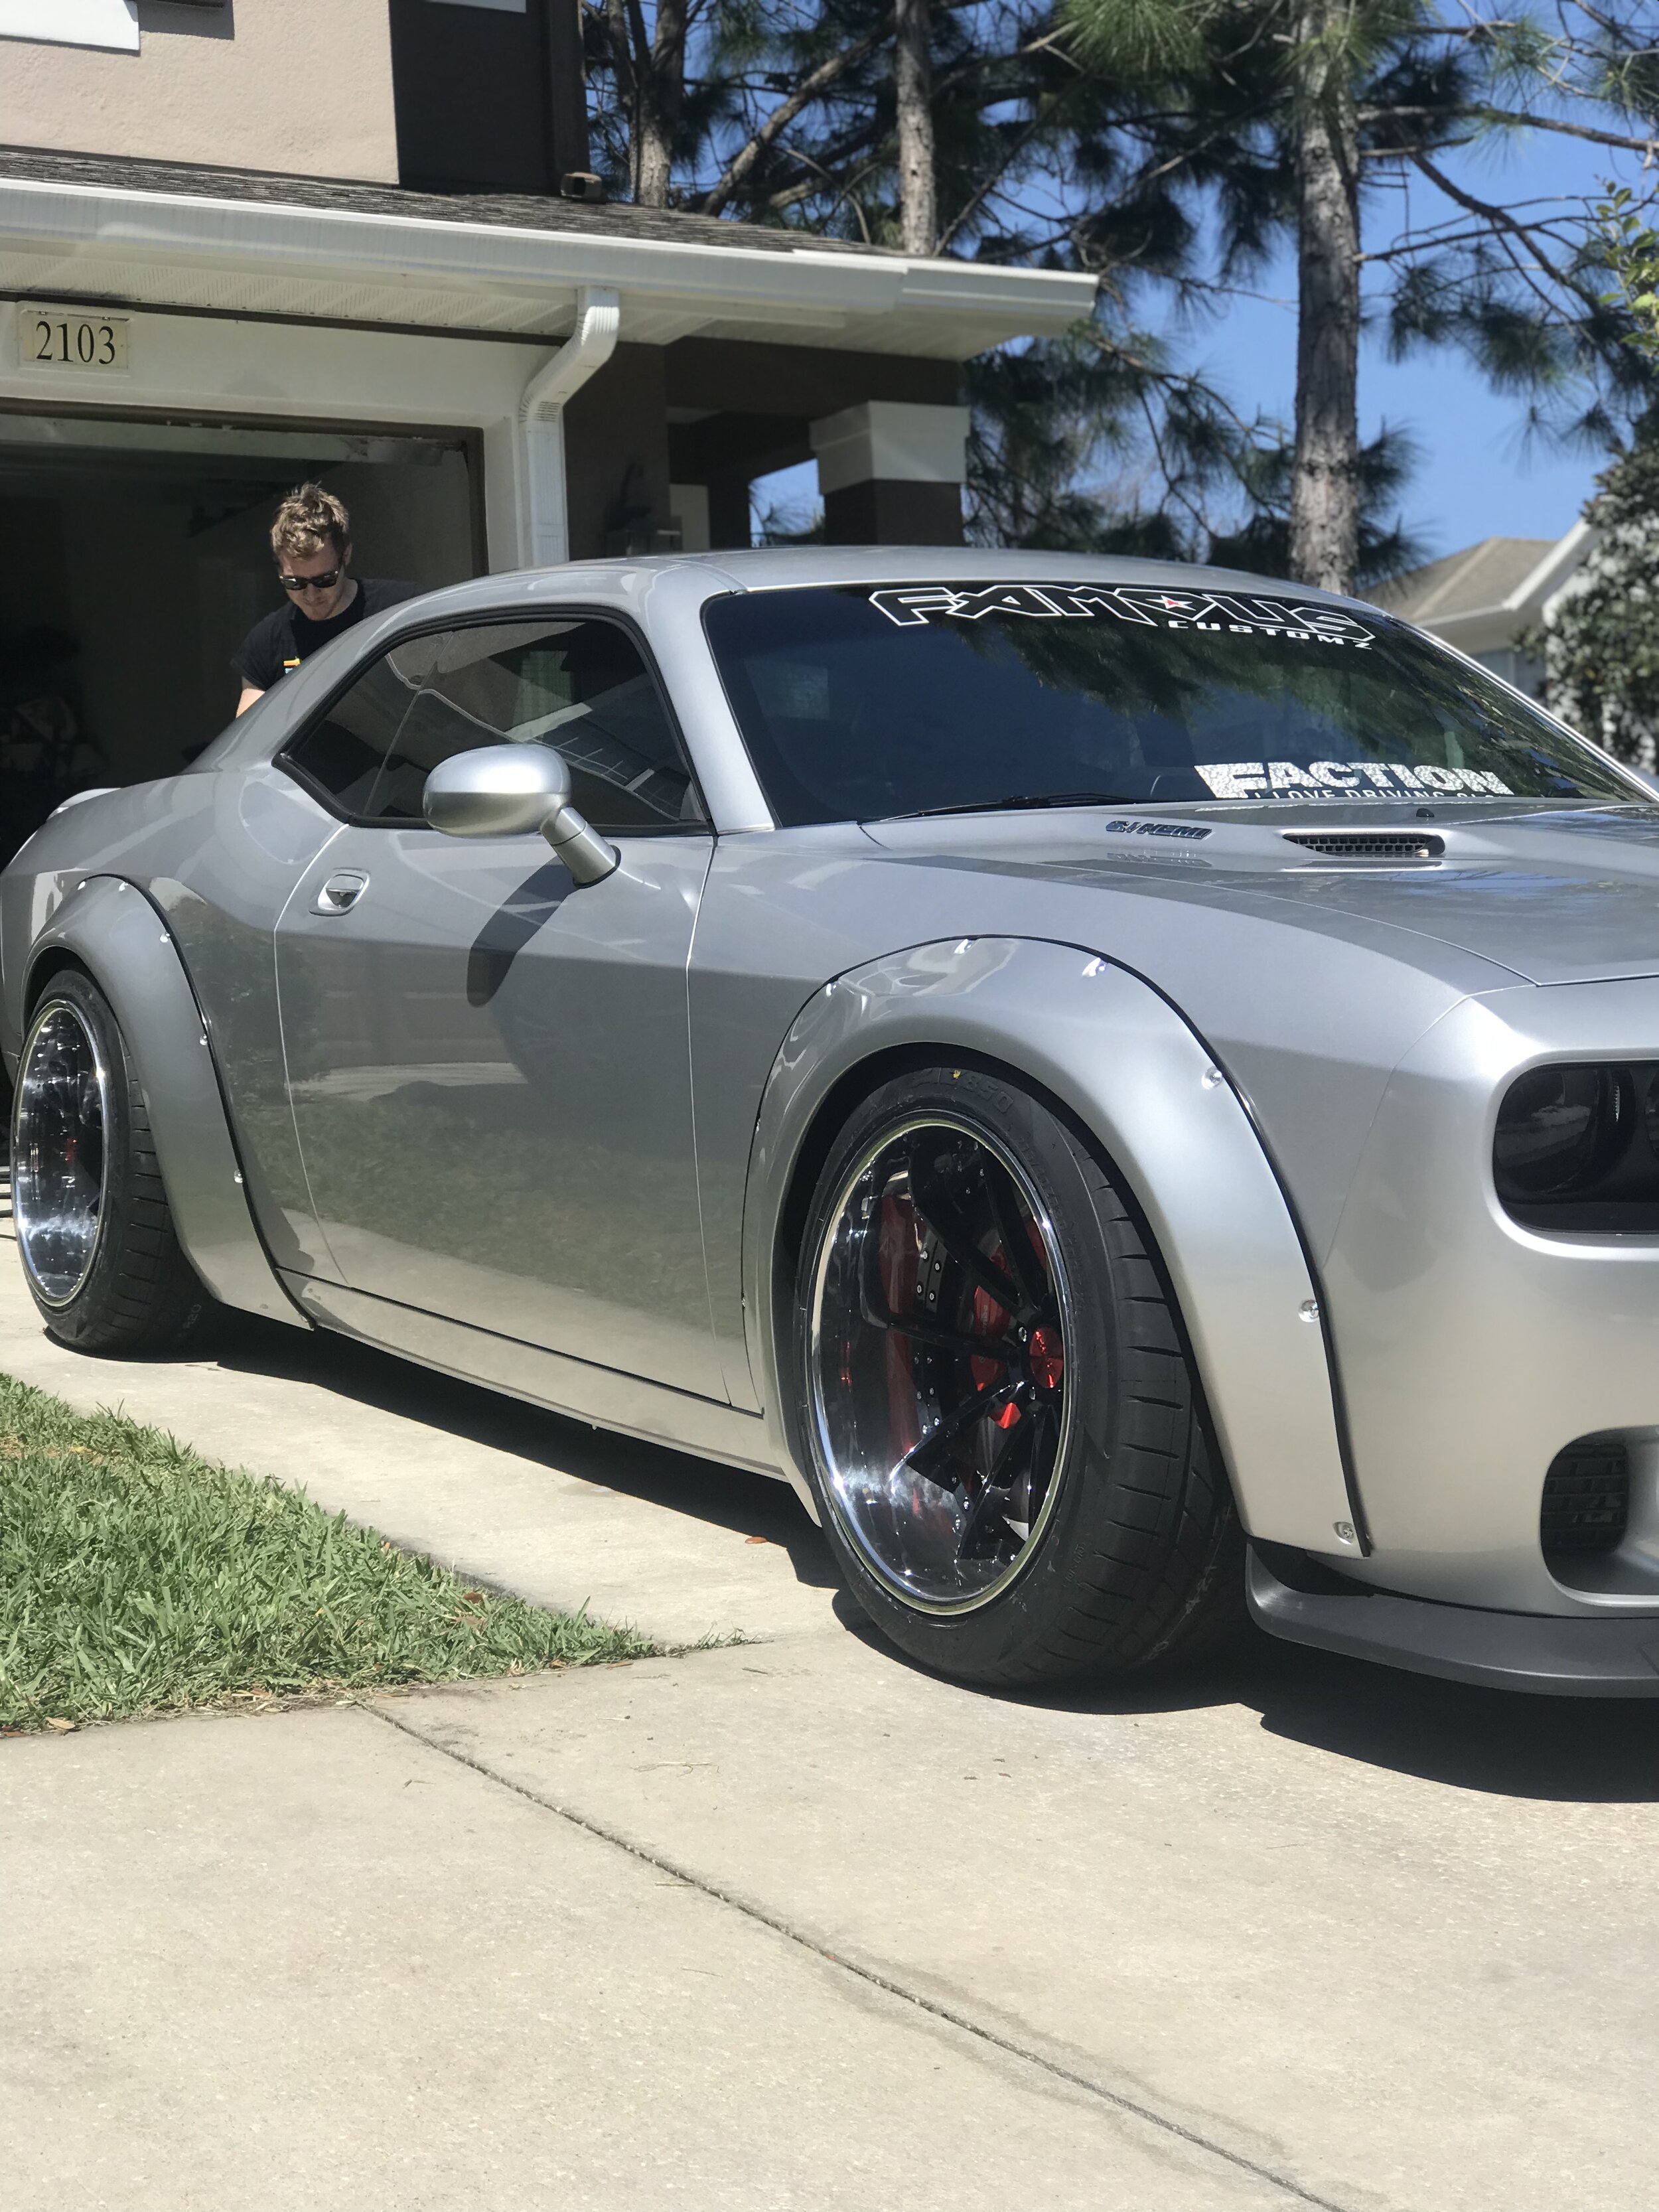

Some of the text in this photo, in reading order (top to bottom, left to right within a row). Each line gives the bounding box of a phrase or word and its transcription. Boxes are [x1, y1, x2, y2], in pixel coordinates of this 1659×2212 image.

[36, 320, 115, 364] 2103
[869, 584, 1376, 642] FAMOUS
[1168, 620, 1372, 650] CUSTOMZ
[1194, 761, 1515, 799] FACTION
